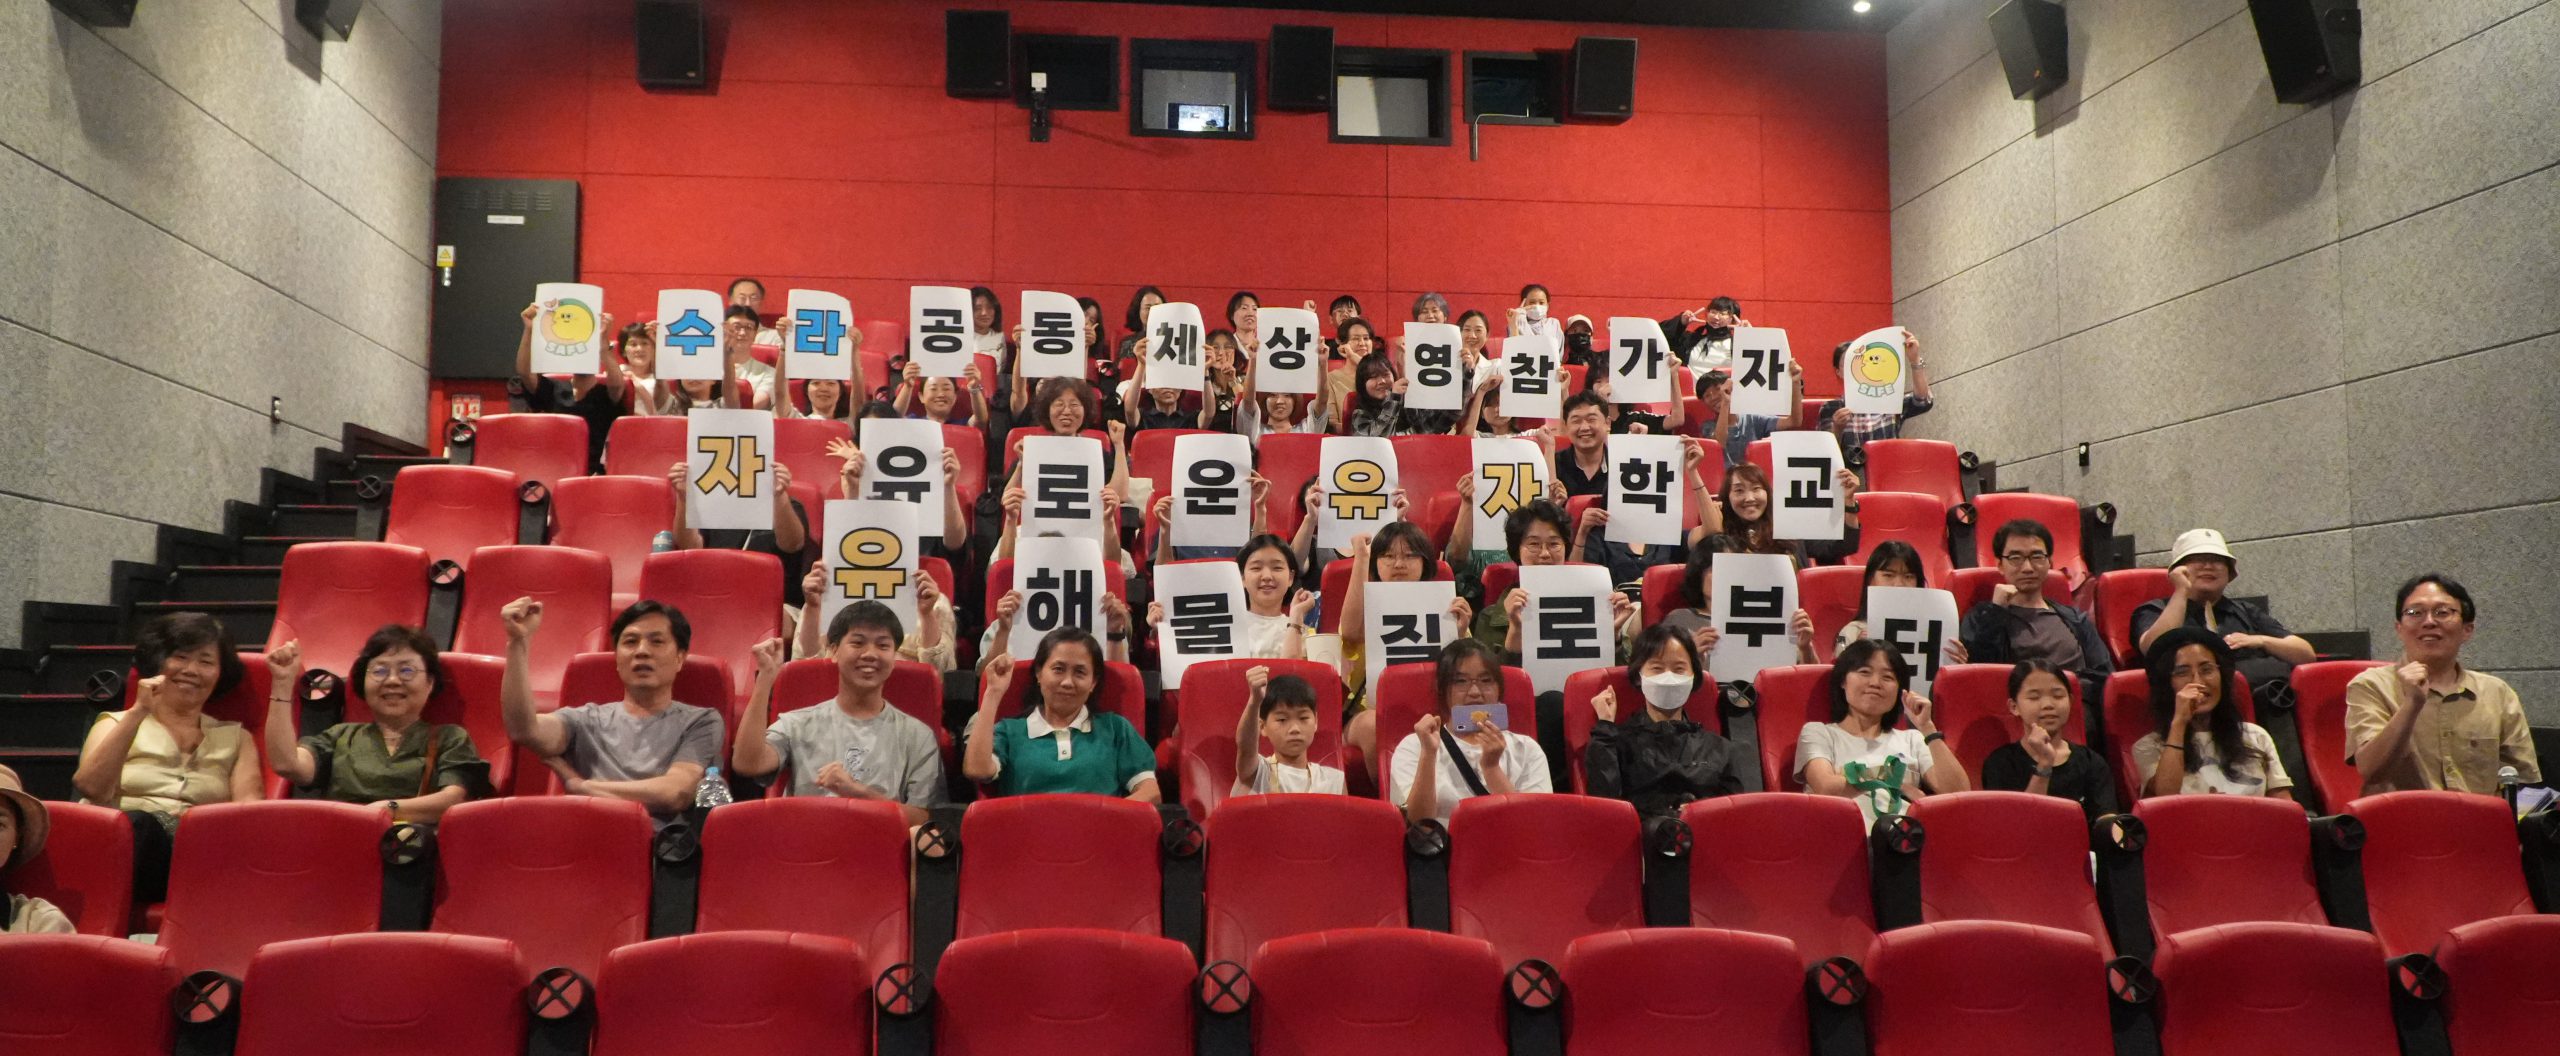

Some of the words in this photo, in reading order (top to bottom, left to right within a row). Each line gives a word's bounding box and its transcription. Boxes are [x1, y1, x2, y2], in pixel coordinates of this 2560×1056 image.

[545, 341, 588, 356] SAFE
[667, 310, 714, 355] 수
[795, 309, 846, 355] 라
[921, 309, 964, 353] 공
[1032, 312, 1074, 354] 동
[1154, 323, 1197, 366] 체
[1265, 327, 1311, 370] 상
[1415, 344, 1451, 386] 영
[1510, 353, 1554, 394] 참
[1619, 339, 1663, 379] 가
[1740, 350, 1784, 390] 자
[1858, 383, 1895, 397] SAFE
[695, 436, 765, 498] 자
[872, 446, 931, 503] 유
[1035, 464, 1090, 519] 로
[1184, 460, 1238, 515] 운
[1329, 460, 1388, 520] 유
[1480, 462, 1543, 518] 자
[1620, 458, 1674, 513] 학
[1785, 457, 1833, 508] 교
[834, 527, 906, 599] 유
[1027, 568, 1092, 633] 해
[1170, 593, 1233, 654] 물
[1726, 586, 1785, 647] 부
[1380, 614, 1442, 666] 질
[1537, 597, 1600, 659] 로
[1884, 618, 1942, 681] 터
